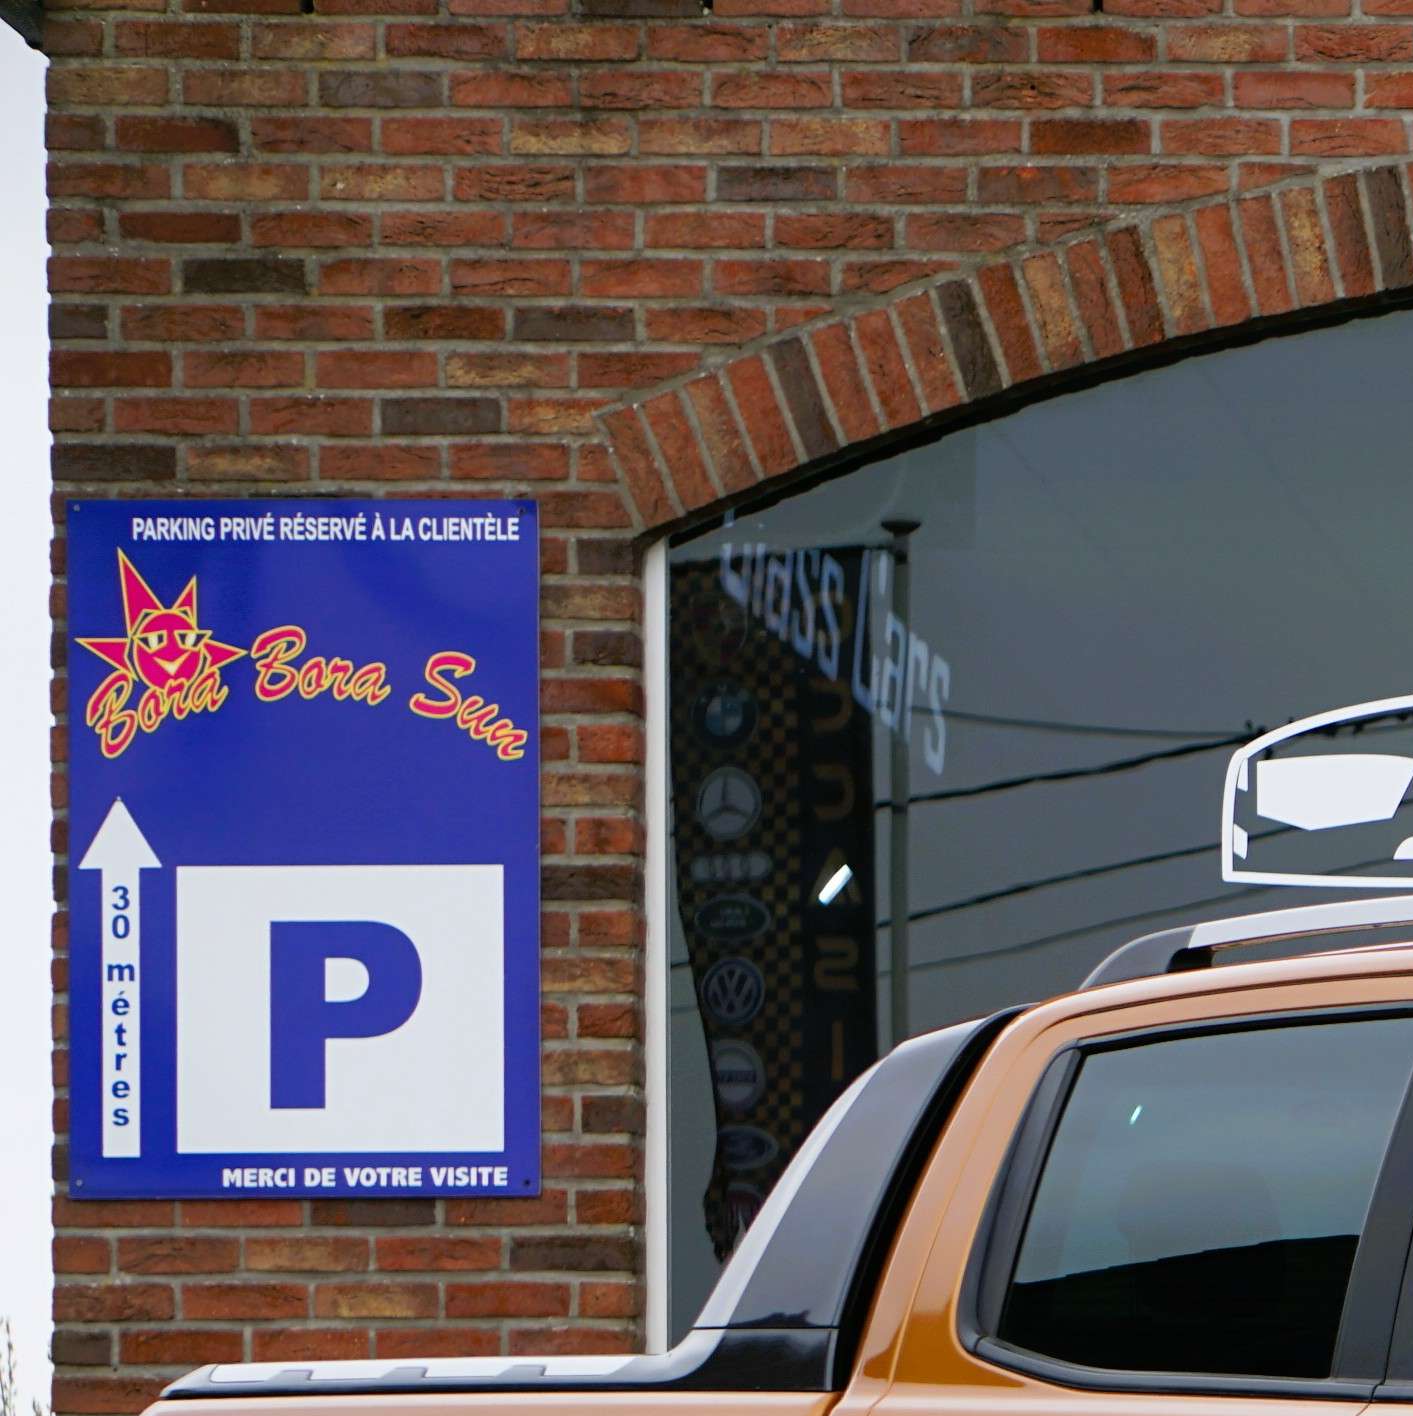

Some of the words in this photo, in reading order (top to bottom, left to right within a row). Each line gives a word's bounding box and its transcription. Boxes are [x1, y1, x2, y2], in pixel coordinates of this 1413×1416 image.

[132, 517, 215, 541] PARKING
[220, 512, 275, 541] PRIVÉ
[279, 512, 367, 541] RÉSERVÉ
[371, 512, 387, 541] À
[390, 517, 415, 541] LA
[418, 512, 520, 541] CLIENTÈLE
[86, 669, 229, 759] Bora
[250, 625, 392, 706] Bora
[409, 651, 528, 760] Sun
[111, 885, 130, 939] 30
[270, 920, 422, 1110] P
[222, 1166, 296, 1188] MERCI
[303, 1167, 336, 1188] DE
[343, 1166, 423, 1187] VOTRE
[429, 1166, 508, 1187] VISITE
